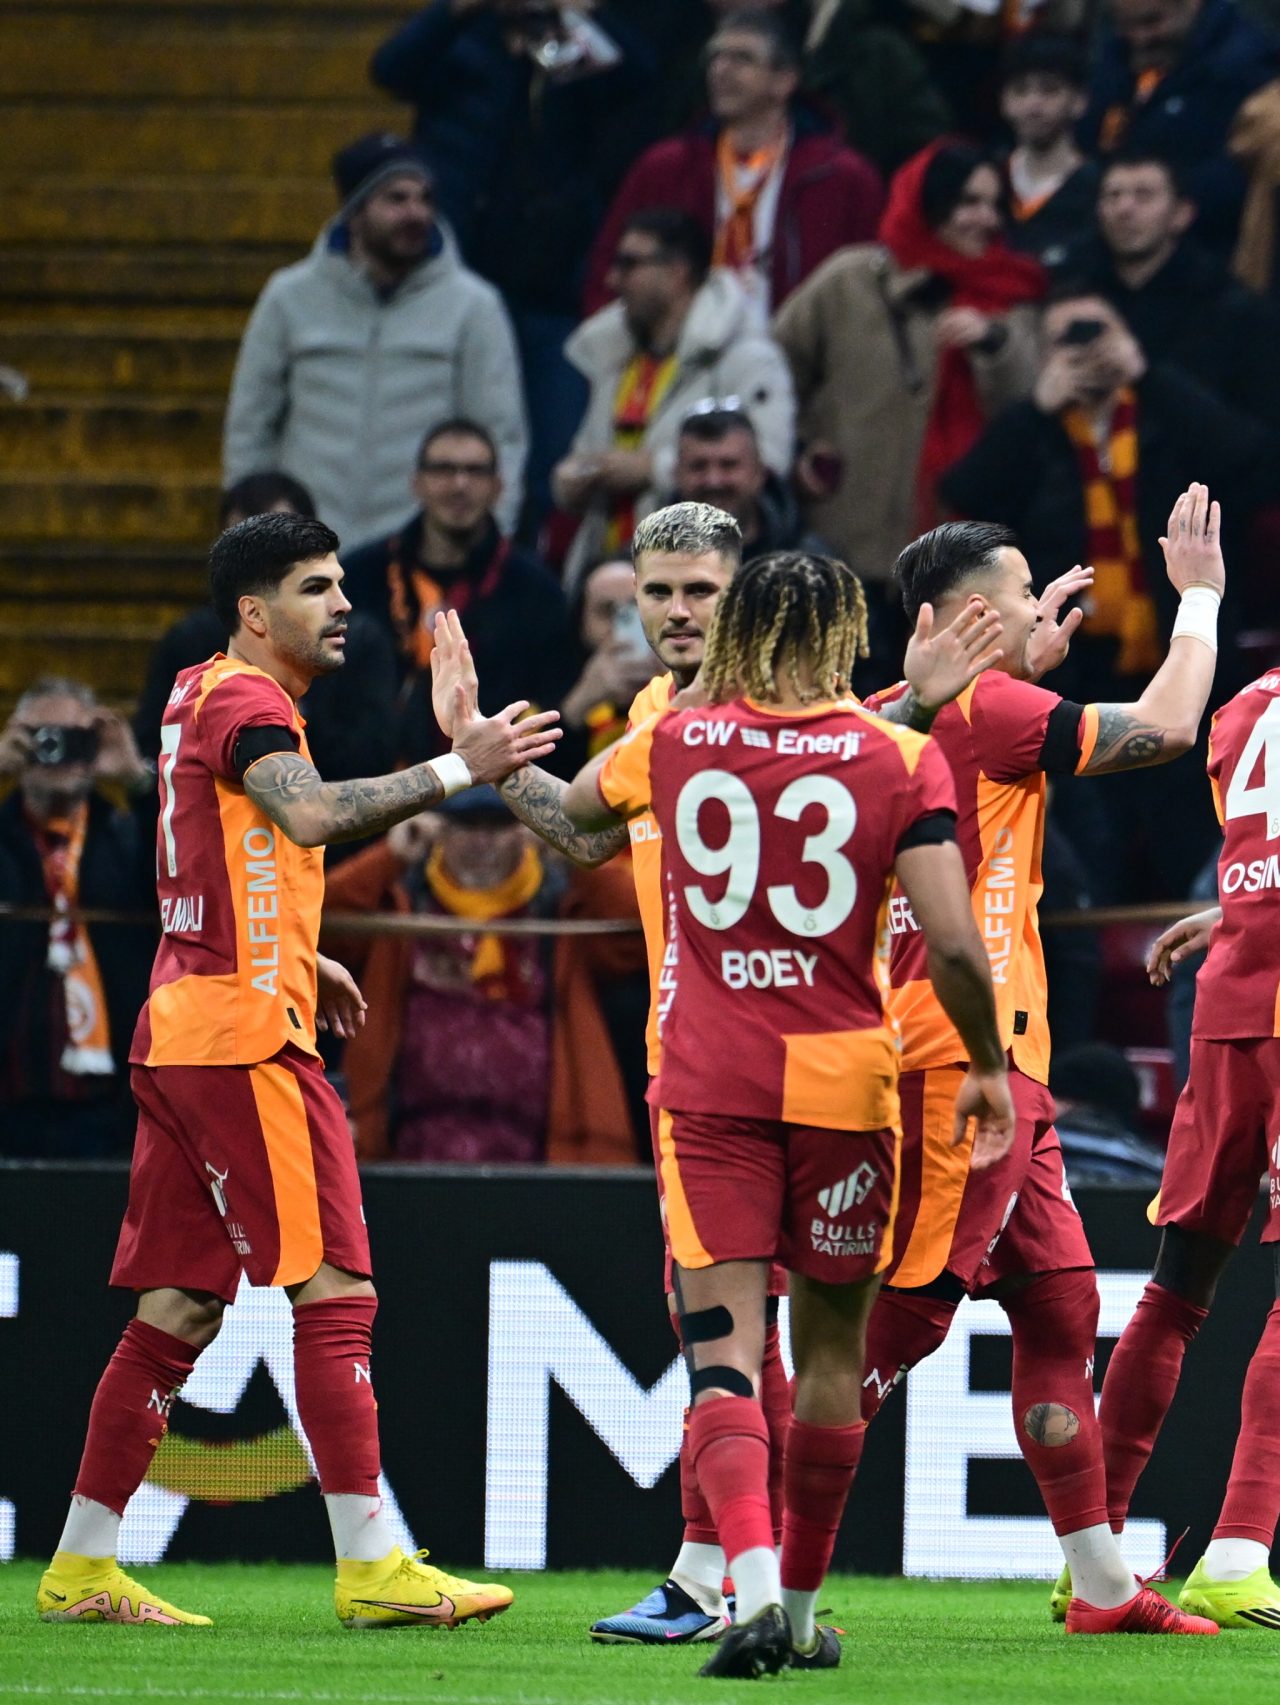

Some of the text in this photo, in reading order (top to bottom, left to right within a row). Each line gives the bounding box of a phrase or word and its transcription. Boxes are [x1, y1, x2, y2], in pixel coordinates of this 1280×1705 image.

[683, 720, 861, 761] CW Enerji
[157, 723, 182, 879] 7
[675, 768, 858, 938] 93
[243, 827, 280, 996] ALFEMO
[984, 826, 1016, 985] ALFEMO
[721, 949, 818, 990] BOEY
[811, 1219, 877, 1242] BULLS
[811, 1234, 876, 1257] YATIRIM
